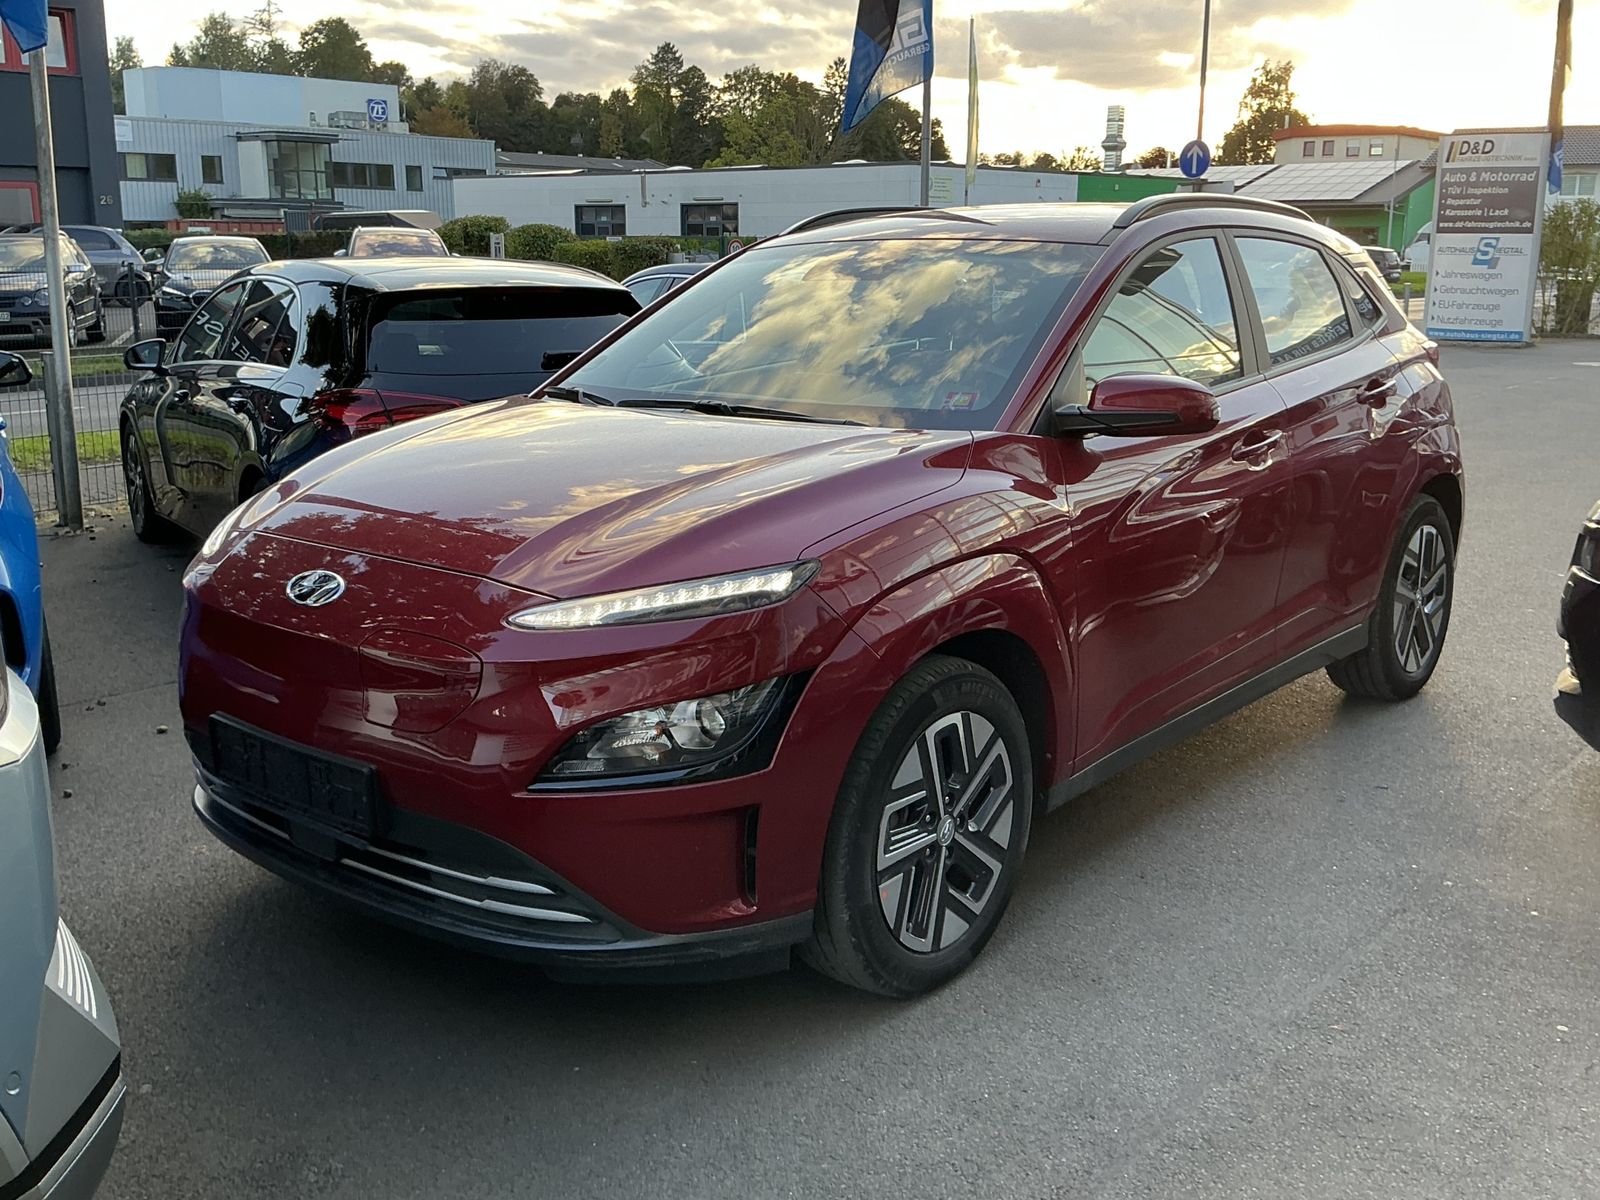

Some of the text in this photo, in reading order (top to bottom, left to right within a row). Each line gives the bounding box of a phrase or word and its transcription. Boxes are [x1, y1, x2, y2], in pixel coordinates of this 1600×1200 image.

[1459, 139, 1495, 156] D&D
[1442, 170, 1537, 183] Auto & Motorrad
[1467, 186, 1509, 195] Inspektion
[100, 194, 113, 205] 26
[1489, 208, 1510, 216] Lack
[1440, 271, 1503, 281] Jahreswagen
[1439, 285, 1520, 297] Gebrauchtwagen
[1438, 299, 1501, 312] EU-Fahrzeuge
[1437, 314, 1504, 328] Nutzfahrzeuge
